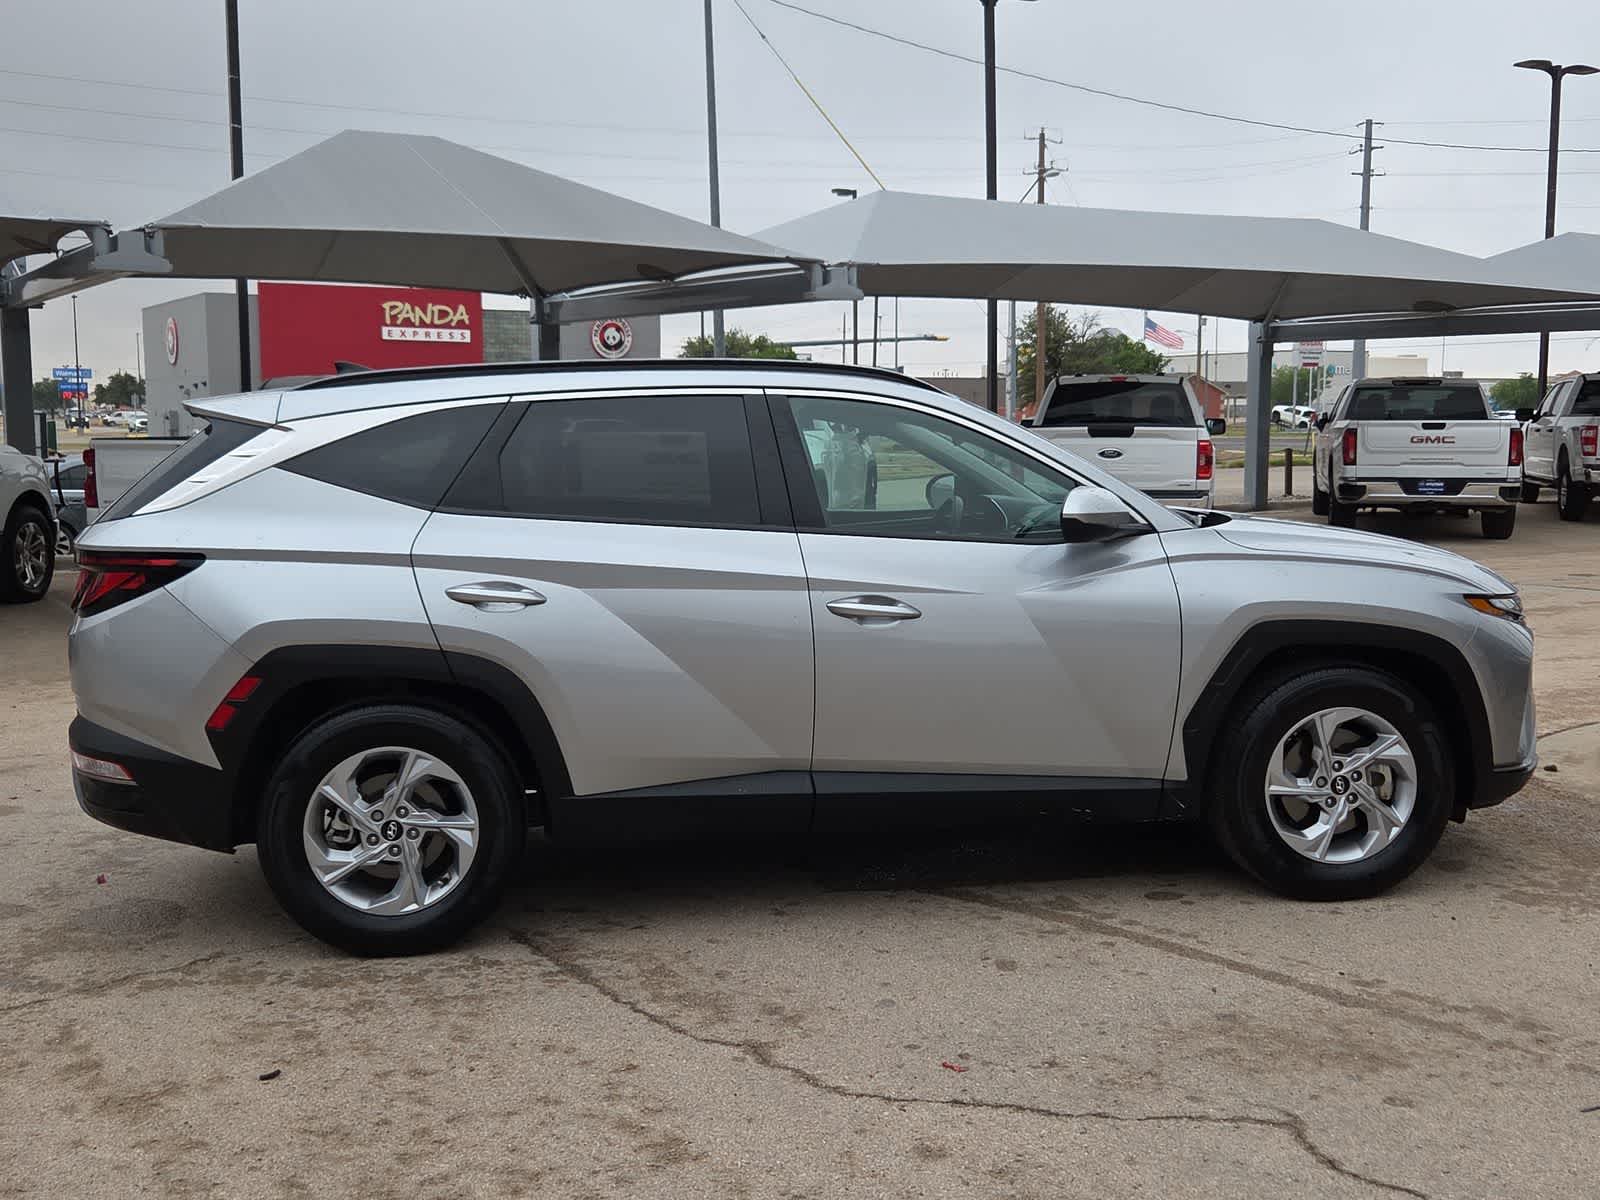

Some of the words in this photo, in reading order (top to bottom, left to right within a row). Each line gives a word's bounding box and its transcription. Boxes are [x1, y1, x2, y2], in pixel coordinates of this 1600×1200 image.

[382, 301, 469, 326] PANDA
[387, 329, 467, 340] EXPRESS
[1410, 435, 1456, 444] GMC
